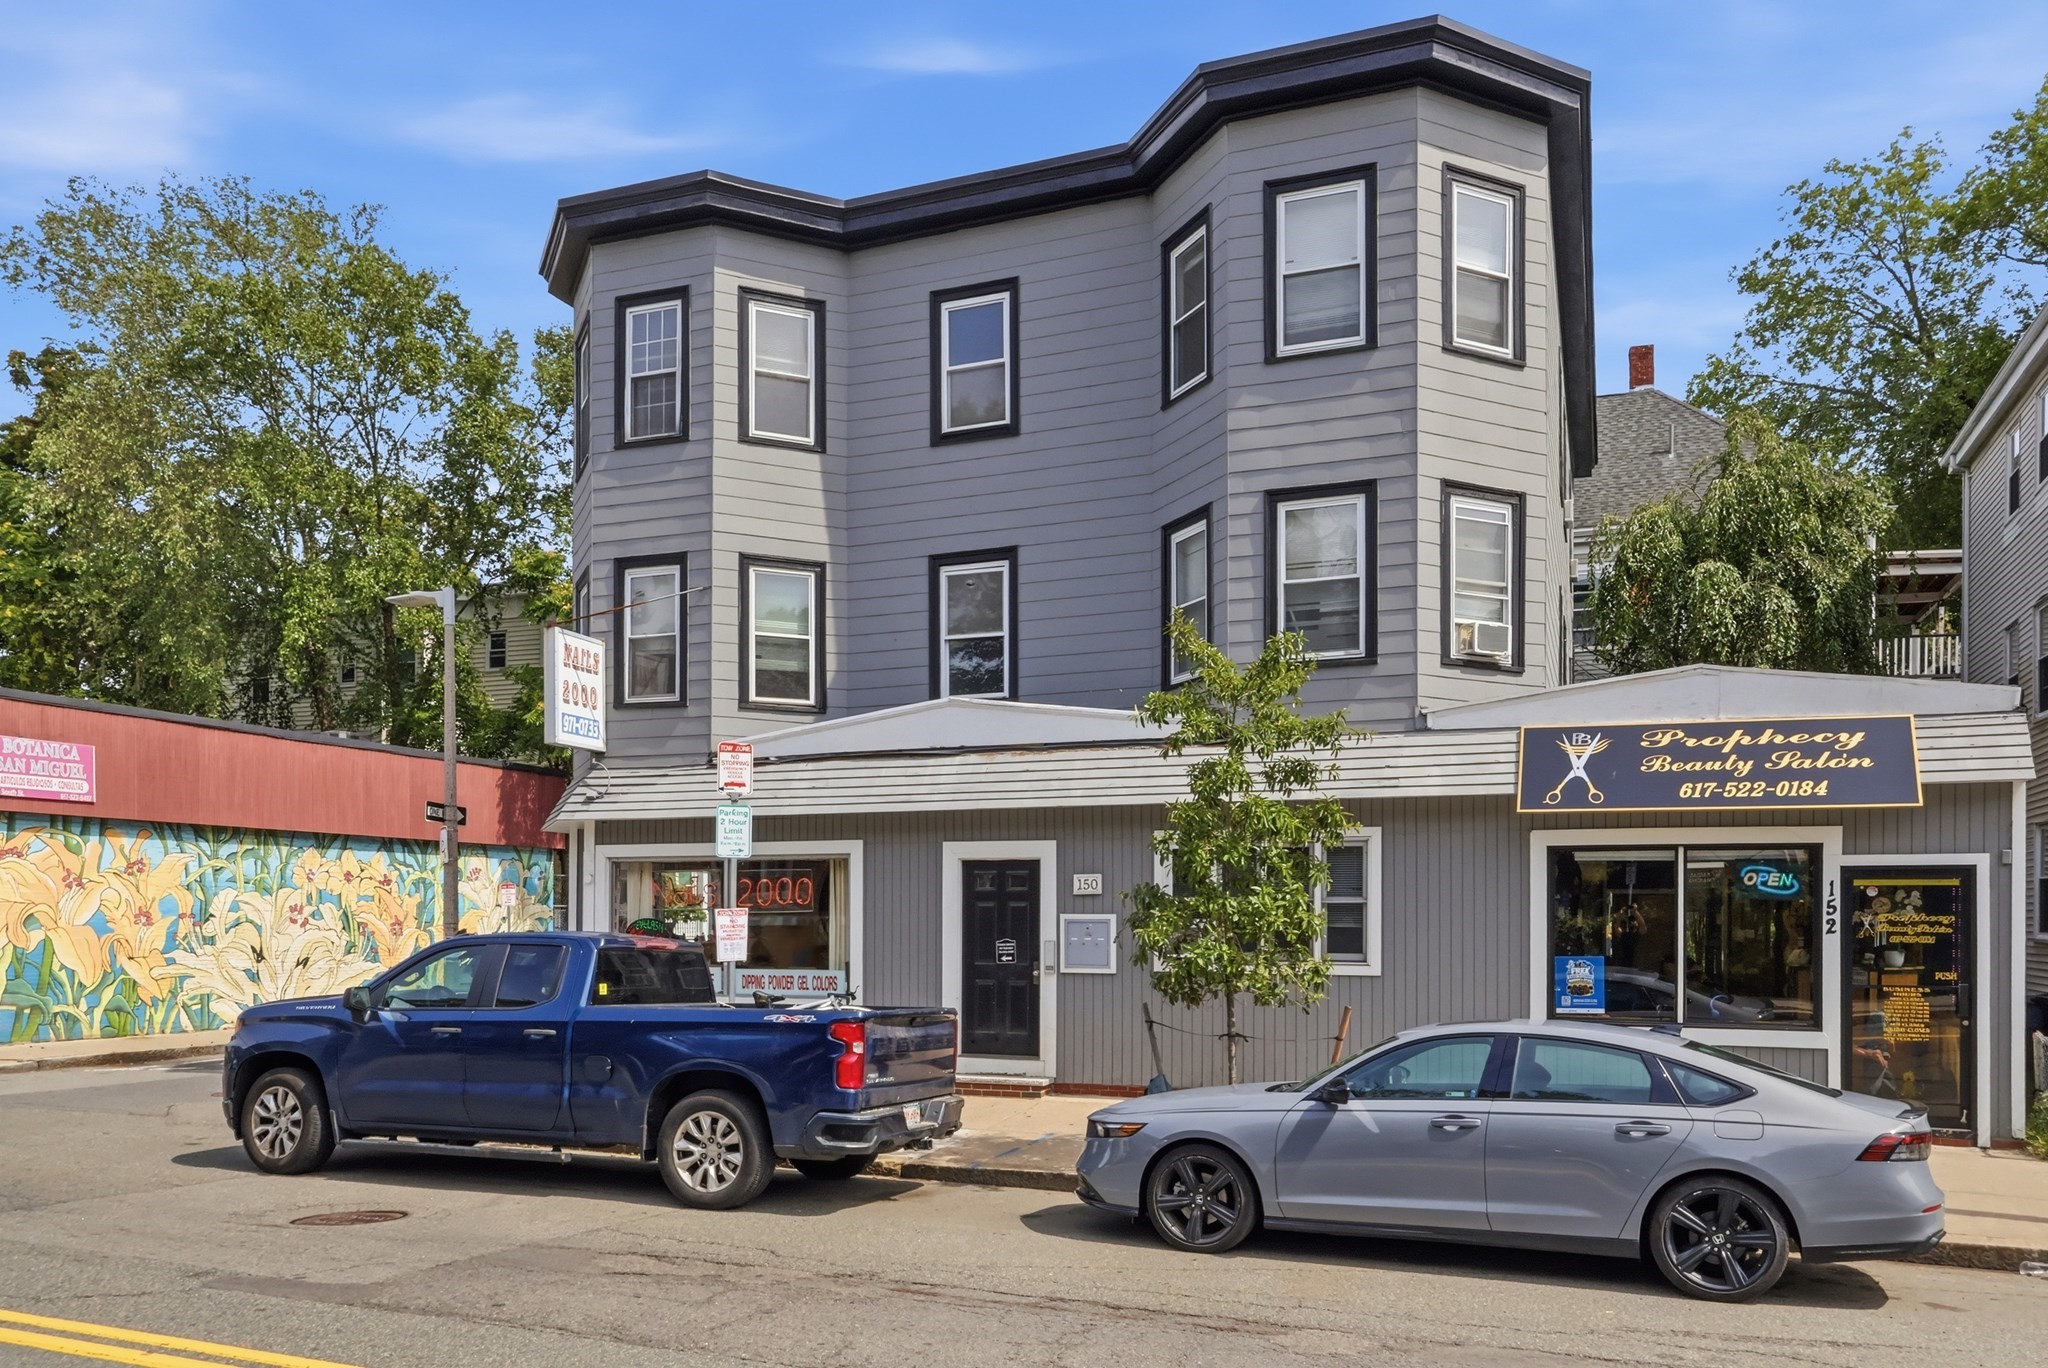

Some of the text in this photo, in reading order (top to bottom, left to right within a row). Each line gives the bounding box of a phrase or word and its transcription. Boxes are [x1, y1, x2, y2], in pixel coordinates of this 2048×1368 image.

[563, 642, 599, 675] NAILS
[562, 680, 598, 710] 2000
[2, 738, 80, 760] BOTANICA
[1640, 729, 1866, 753] Prophecy
[29, 759, 87, 778] MIGUEL
[1640, 754, 1753, 777] Beauty
[1679, 780, 1829, 798] 617-522-0184
[720, 809, 749, 818] Parking
[1077, 879, 1099, 891] 150
[1743, 872, 1793, 887] OPEN
[738, 877, 813, 906] 2000
[742, 974, 839, 991] DIPPING POWDER GEL COLORS
[1935, 971, 1957, 980] PUSH
